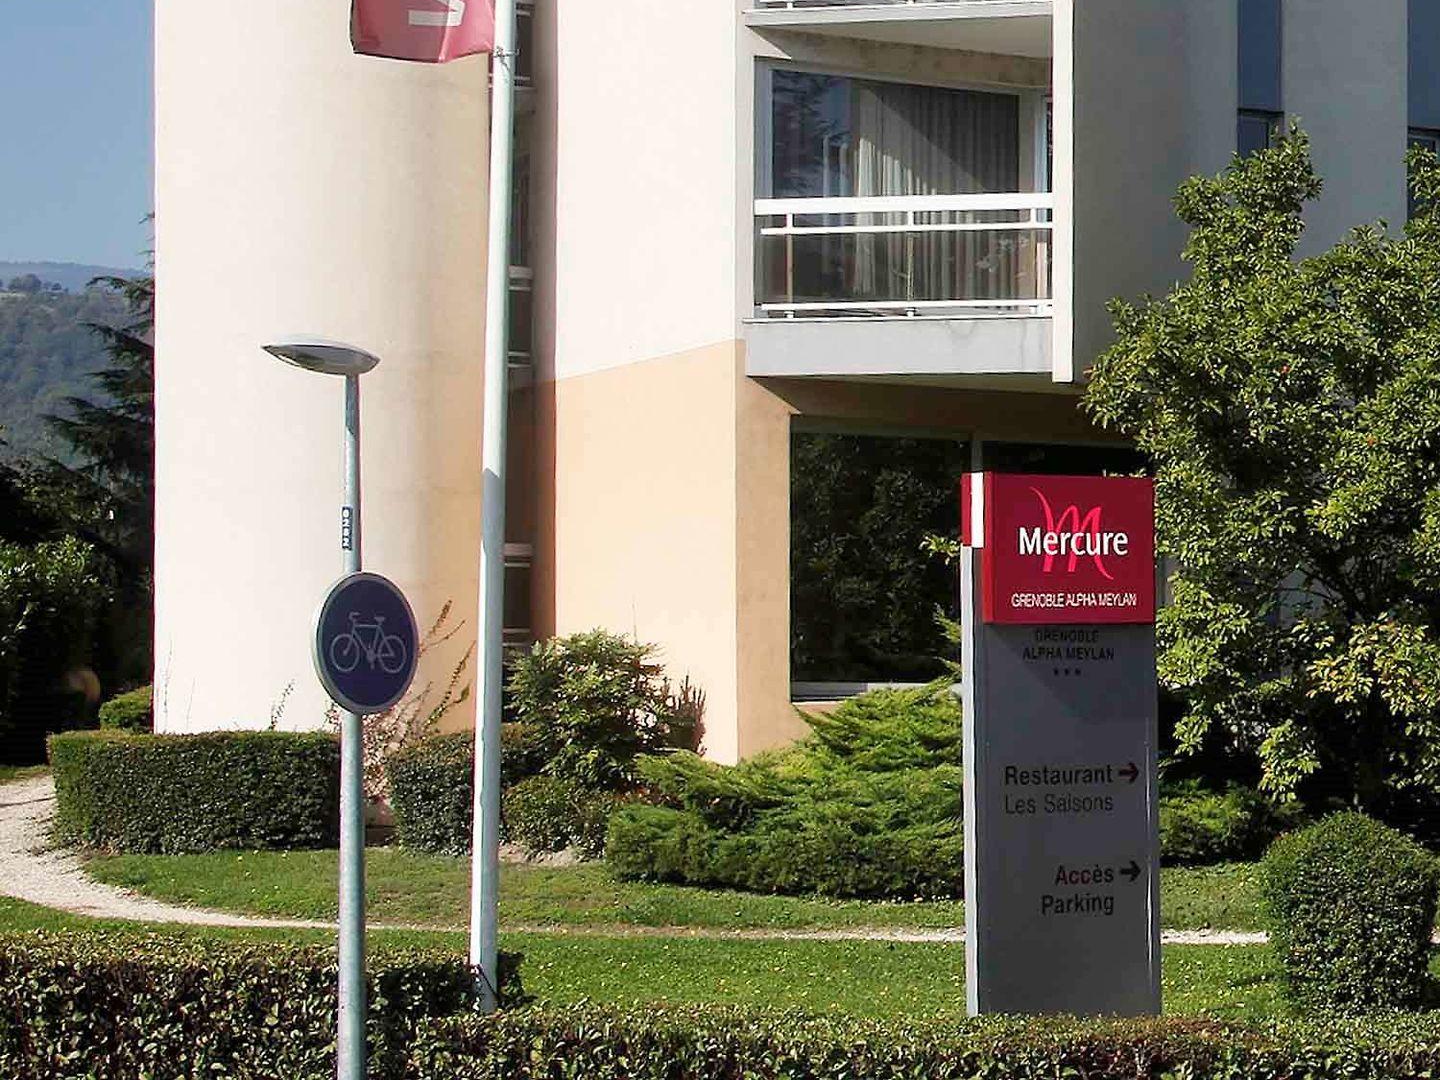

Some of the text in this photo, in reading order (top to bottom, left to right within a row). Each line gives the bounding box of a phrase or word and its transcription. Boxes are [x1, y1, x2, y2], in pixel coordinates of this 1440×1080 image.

[1018, 526, 1128, 556] Mercure
[1011, 592, 1137, 608] GRENOBLE ALPHA MEYLAN
[1022, 647, 1064, 661] ALPHA
[1004, 765, 1113, 786] Restaurant
[1005, 792, 1113, 814] Les Saisons
[1041, 893, 1114, 916] Parking
